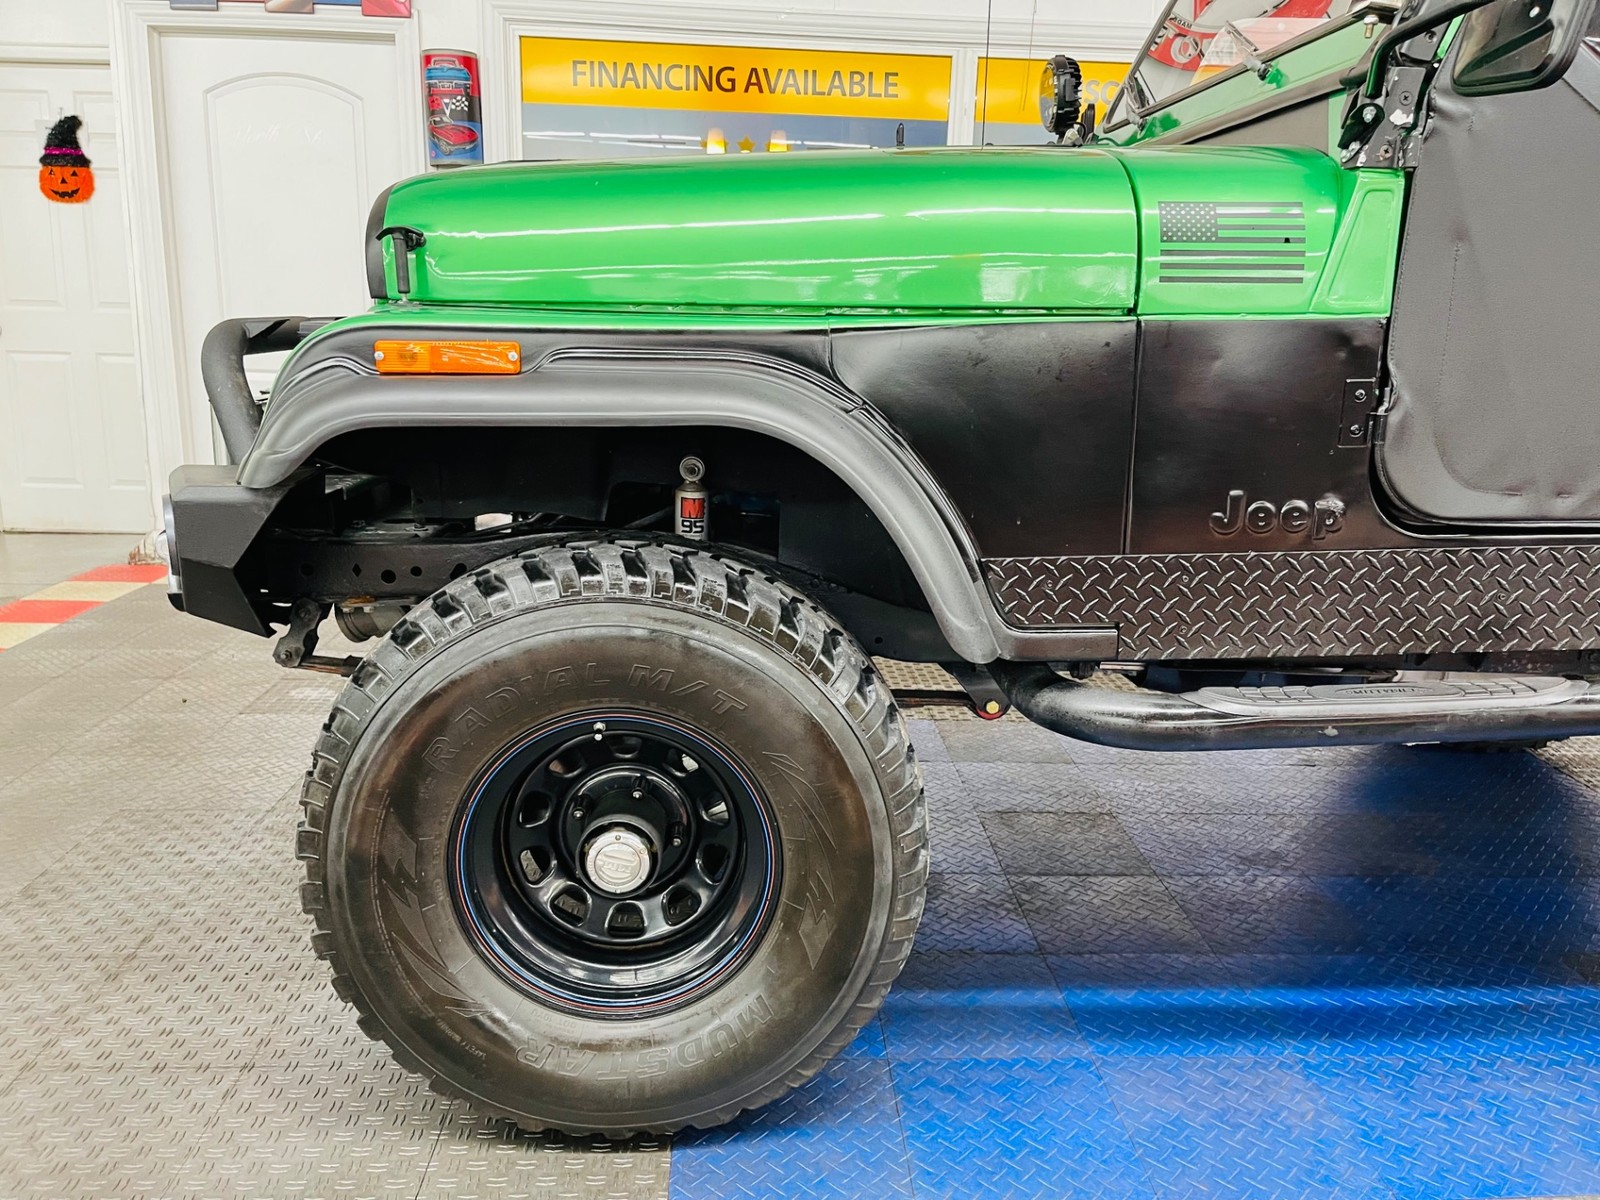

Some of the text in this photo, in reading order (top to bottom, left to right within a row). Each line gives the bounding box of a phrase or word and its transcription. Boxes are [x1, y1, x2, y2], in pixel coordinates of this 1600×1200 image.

[572, 59, 899, 98] FINANCING AVAILABLE
[681, 519, 705, 534] 95
[1209, 489, 1345, 540] Jeep
[421, 662, 611, 773] RADIAL
[626, 663, 748, 715] M/T
[515, 992, 775, 1082] MUDSTAR
